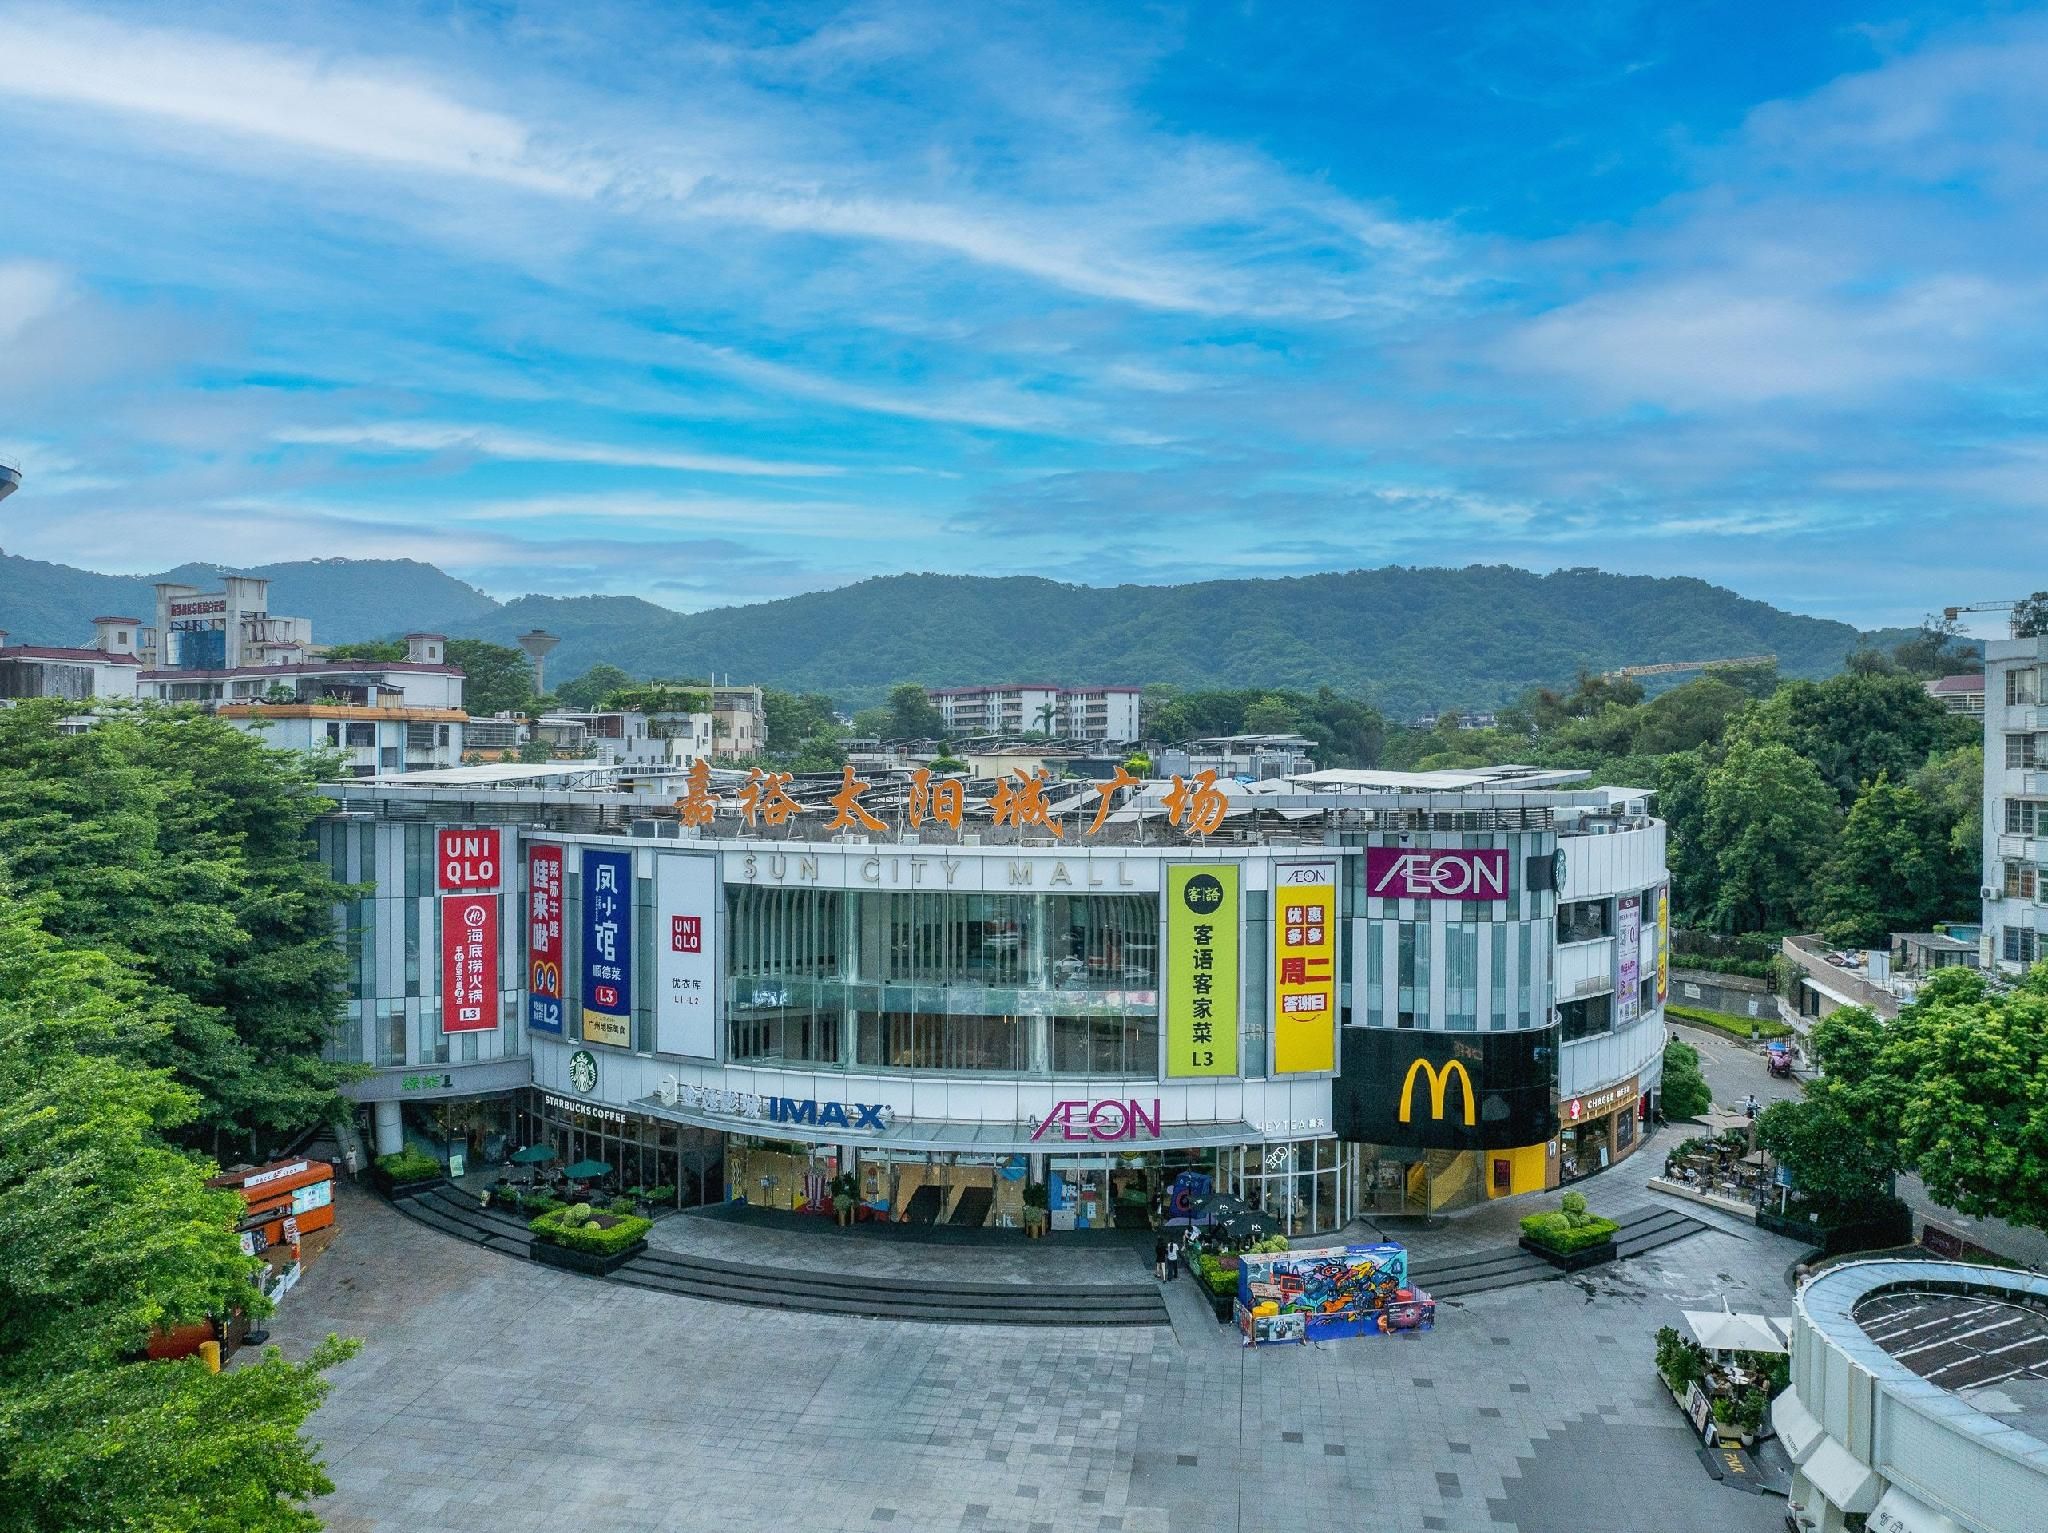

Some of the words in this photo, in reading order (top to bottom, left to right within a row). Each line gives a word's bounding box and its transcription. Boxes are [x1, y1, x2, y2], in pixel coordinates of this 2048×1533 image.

[673, 757, 1229, 838] 嘉裕太阳城广场
[446, 837, 489, 857] UNI
[446, 861, 494, 885] QLO
[743, 854, 820, 881] SUN
[860, 856, 962, 885] CITY
[1008, 860, 1135, 887] MALL
[595, 864, 619, 962] 凤小馆
[1287, 906, 1322, 924] 优惠
[675, 919, 696, 934] UNI
[1287, 927, 1322, 944] 多多
[675, 934, 698, 949] QLO
[467, 928, 482, 1005] 海底捞火锅
[592, 964, 621, 981] 顺德菜
[1280, 957, 1331, 985] 周二
[672, 978, 701, 990] 优衣库
[1192, 924, 1213, 1044] 客语客家菜
[600, 988, 614, 1003] L3
[463, 1009, 477, 1020] L3
[543, 1003, 559, 1025] L2
[1192, 1051, 1213, 1066] L3
[545, 1095, 591, 1116] STARBUCKS
[592, 1107, 626, 1124] COFFEE
[769, 1096, 886, 1130] IMAX
[1256, 1118, 1305, 1132] HEYTEA
